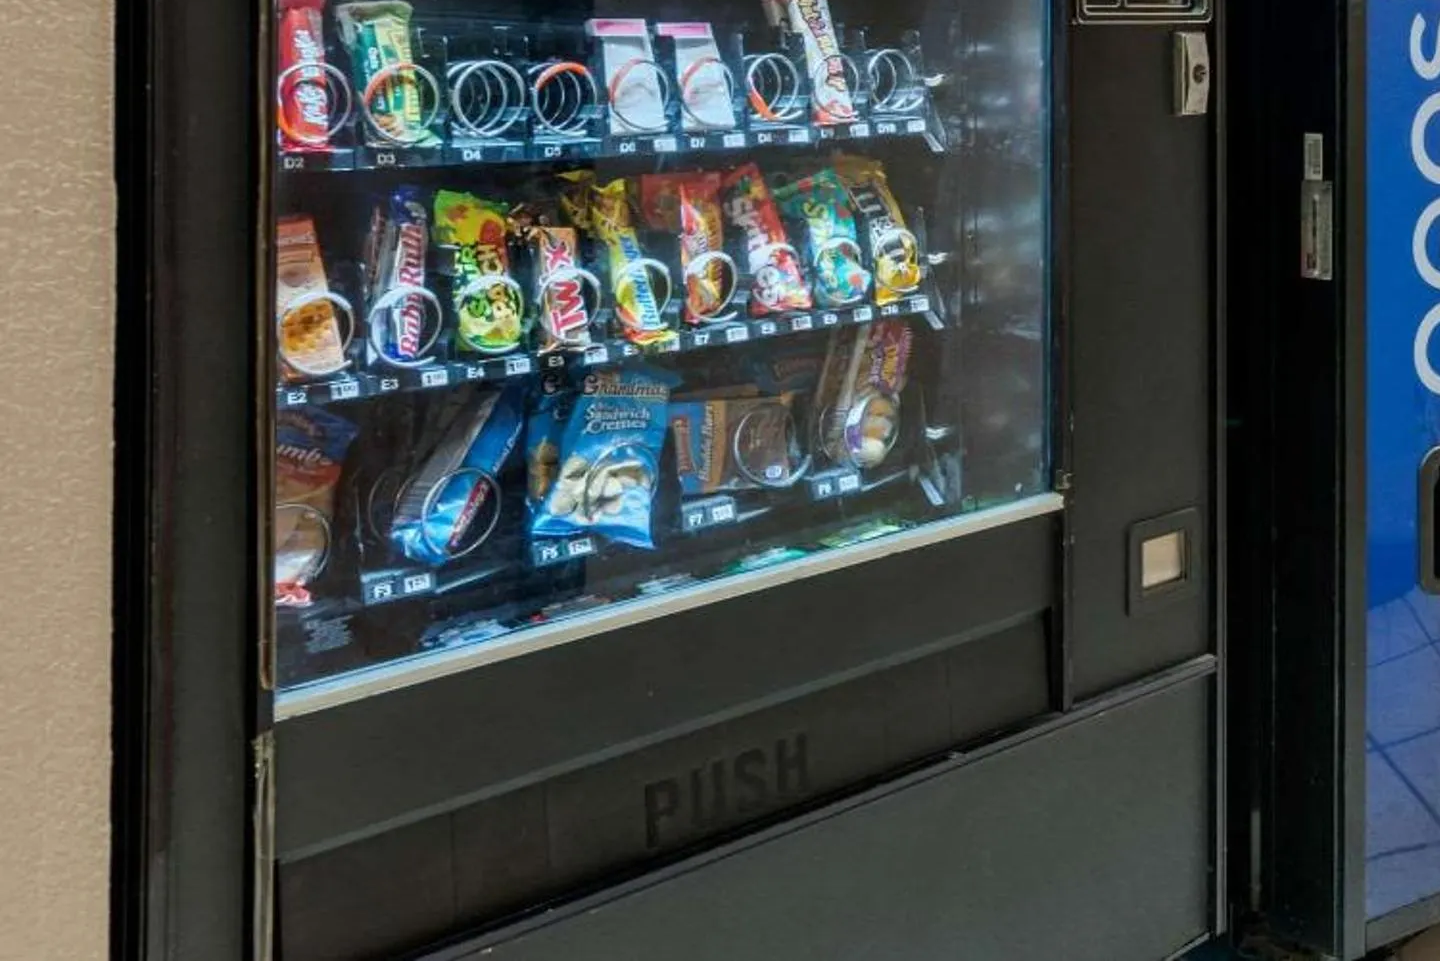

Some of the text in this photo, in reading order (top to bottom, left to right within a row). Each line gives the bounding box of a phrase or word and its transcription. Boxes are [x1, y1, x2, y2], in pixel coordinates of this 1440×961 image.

[545, 243, 587, 336] TWX
[467, 367, 485, 379] E4
[381, 378, 399, 390] E3
[287, 391, 307, 405] E2
[643, 732, 808, 850] PUSH
